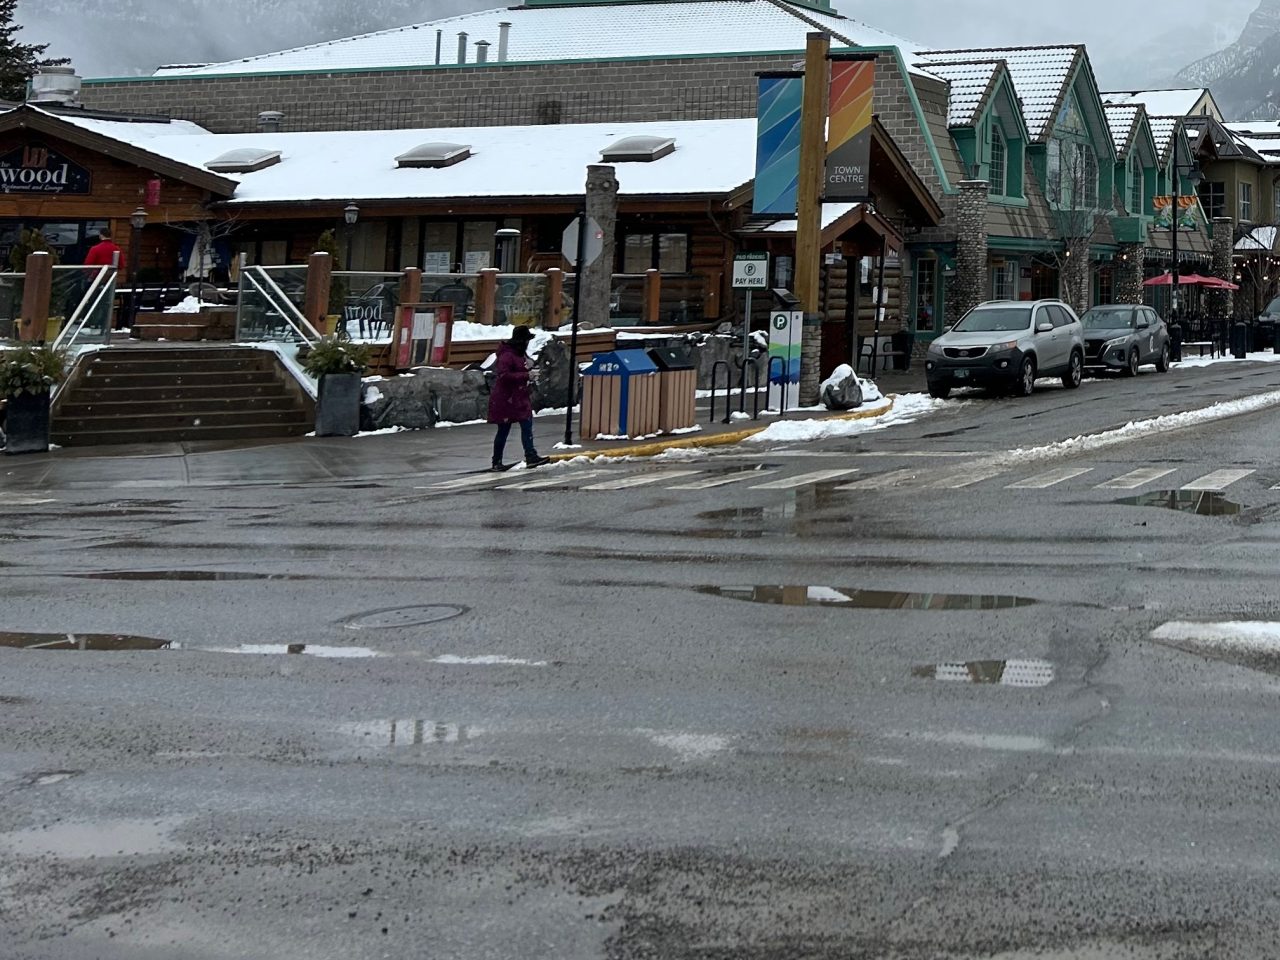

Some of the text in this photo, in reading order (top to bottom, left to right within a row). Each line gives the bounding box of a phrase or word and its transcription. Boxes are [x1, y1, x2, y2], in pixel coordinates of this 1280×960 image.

[0, 163, 69, 185] wood
[834, 166, 861, 174] TOWN
[829, 174, 864, 183] CENTRE
[344, 300, 383, 320] wood
[776, 316, 785, 328] P
